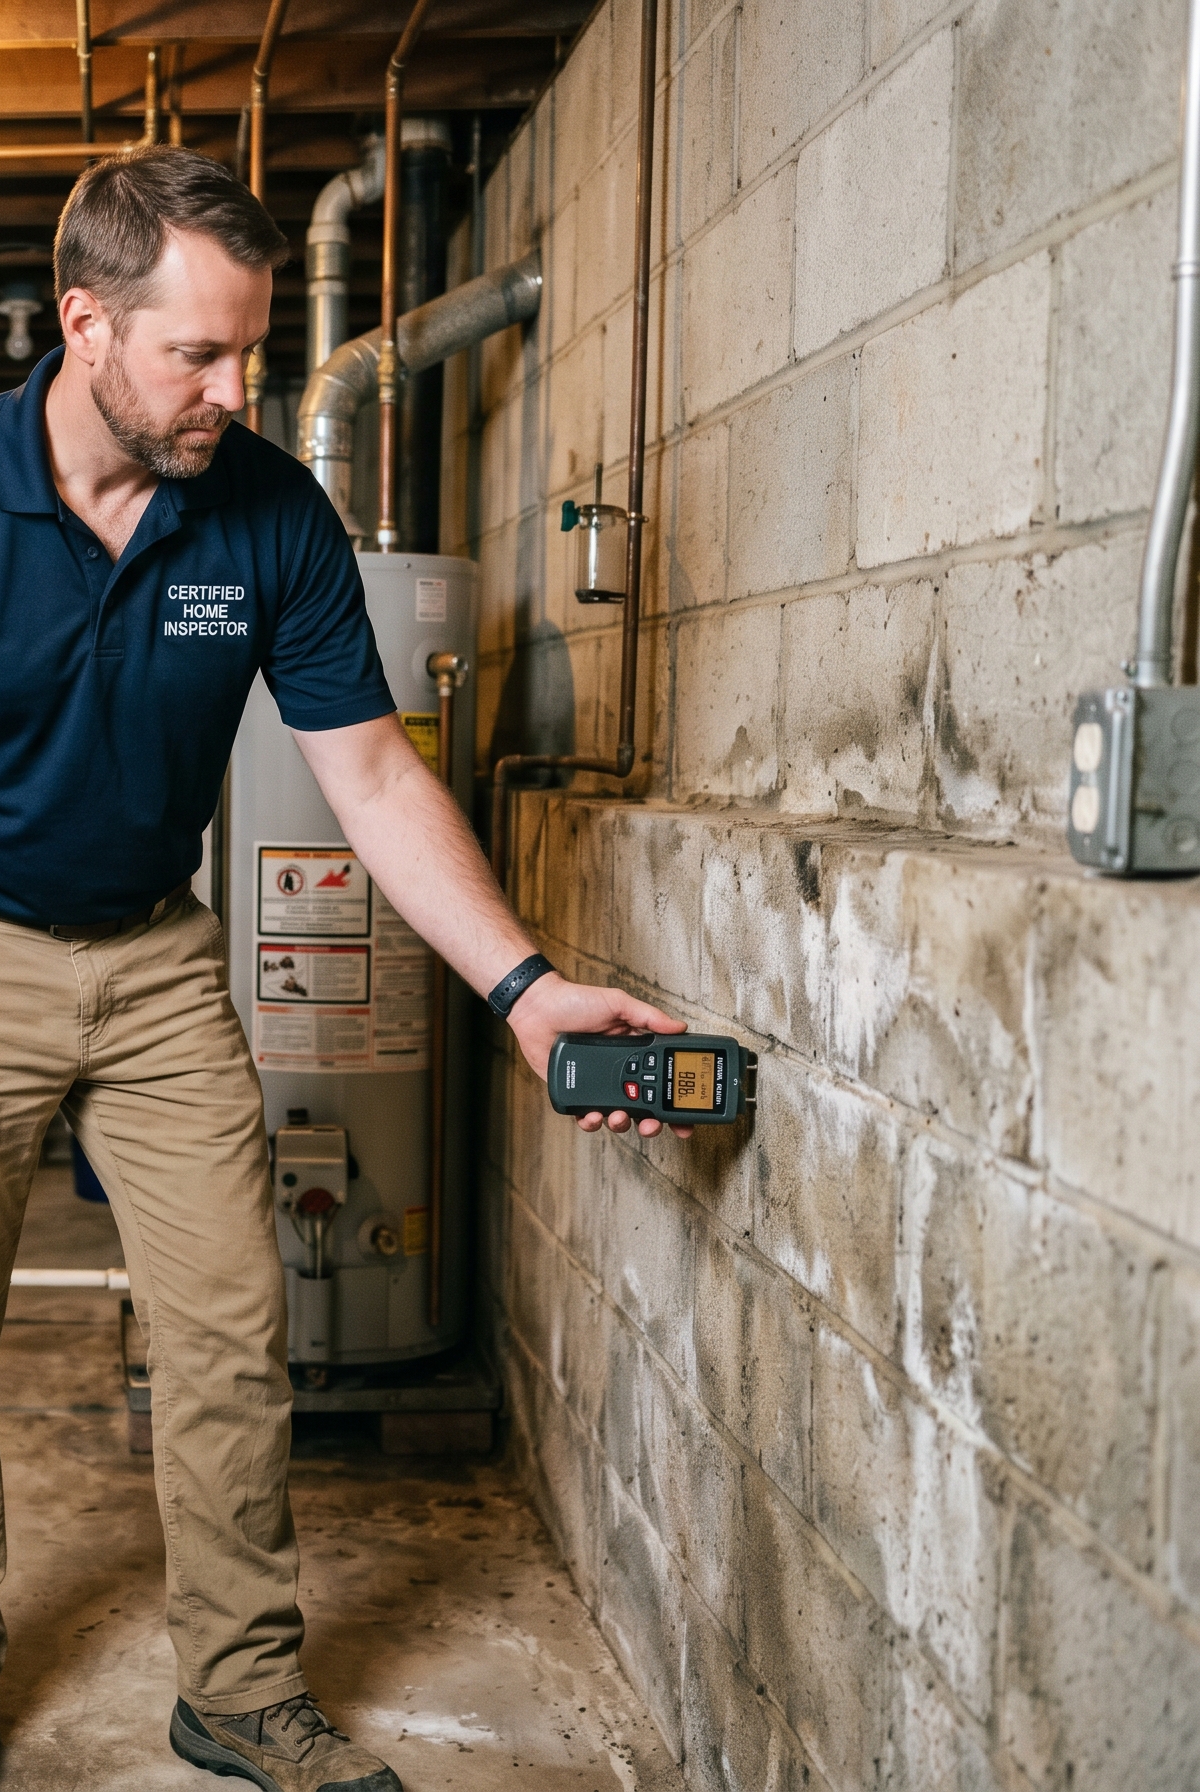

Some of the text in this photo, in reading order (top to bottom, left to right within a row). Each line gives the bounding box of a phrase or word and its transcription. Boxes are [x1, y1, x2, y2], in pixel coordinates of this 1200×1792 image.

[167, 585, 245, 601] CERTIFIED
[183, 604, 229, 619] HOME
[163, 621, 248, 636] INSPECTOR
